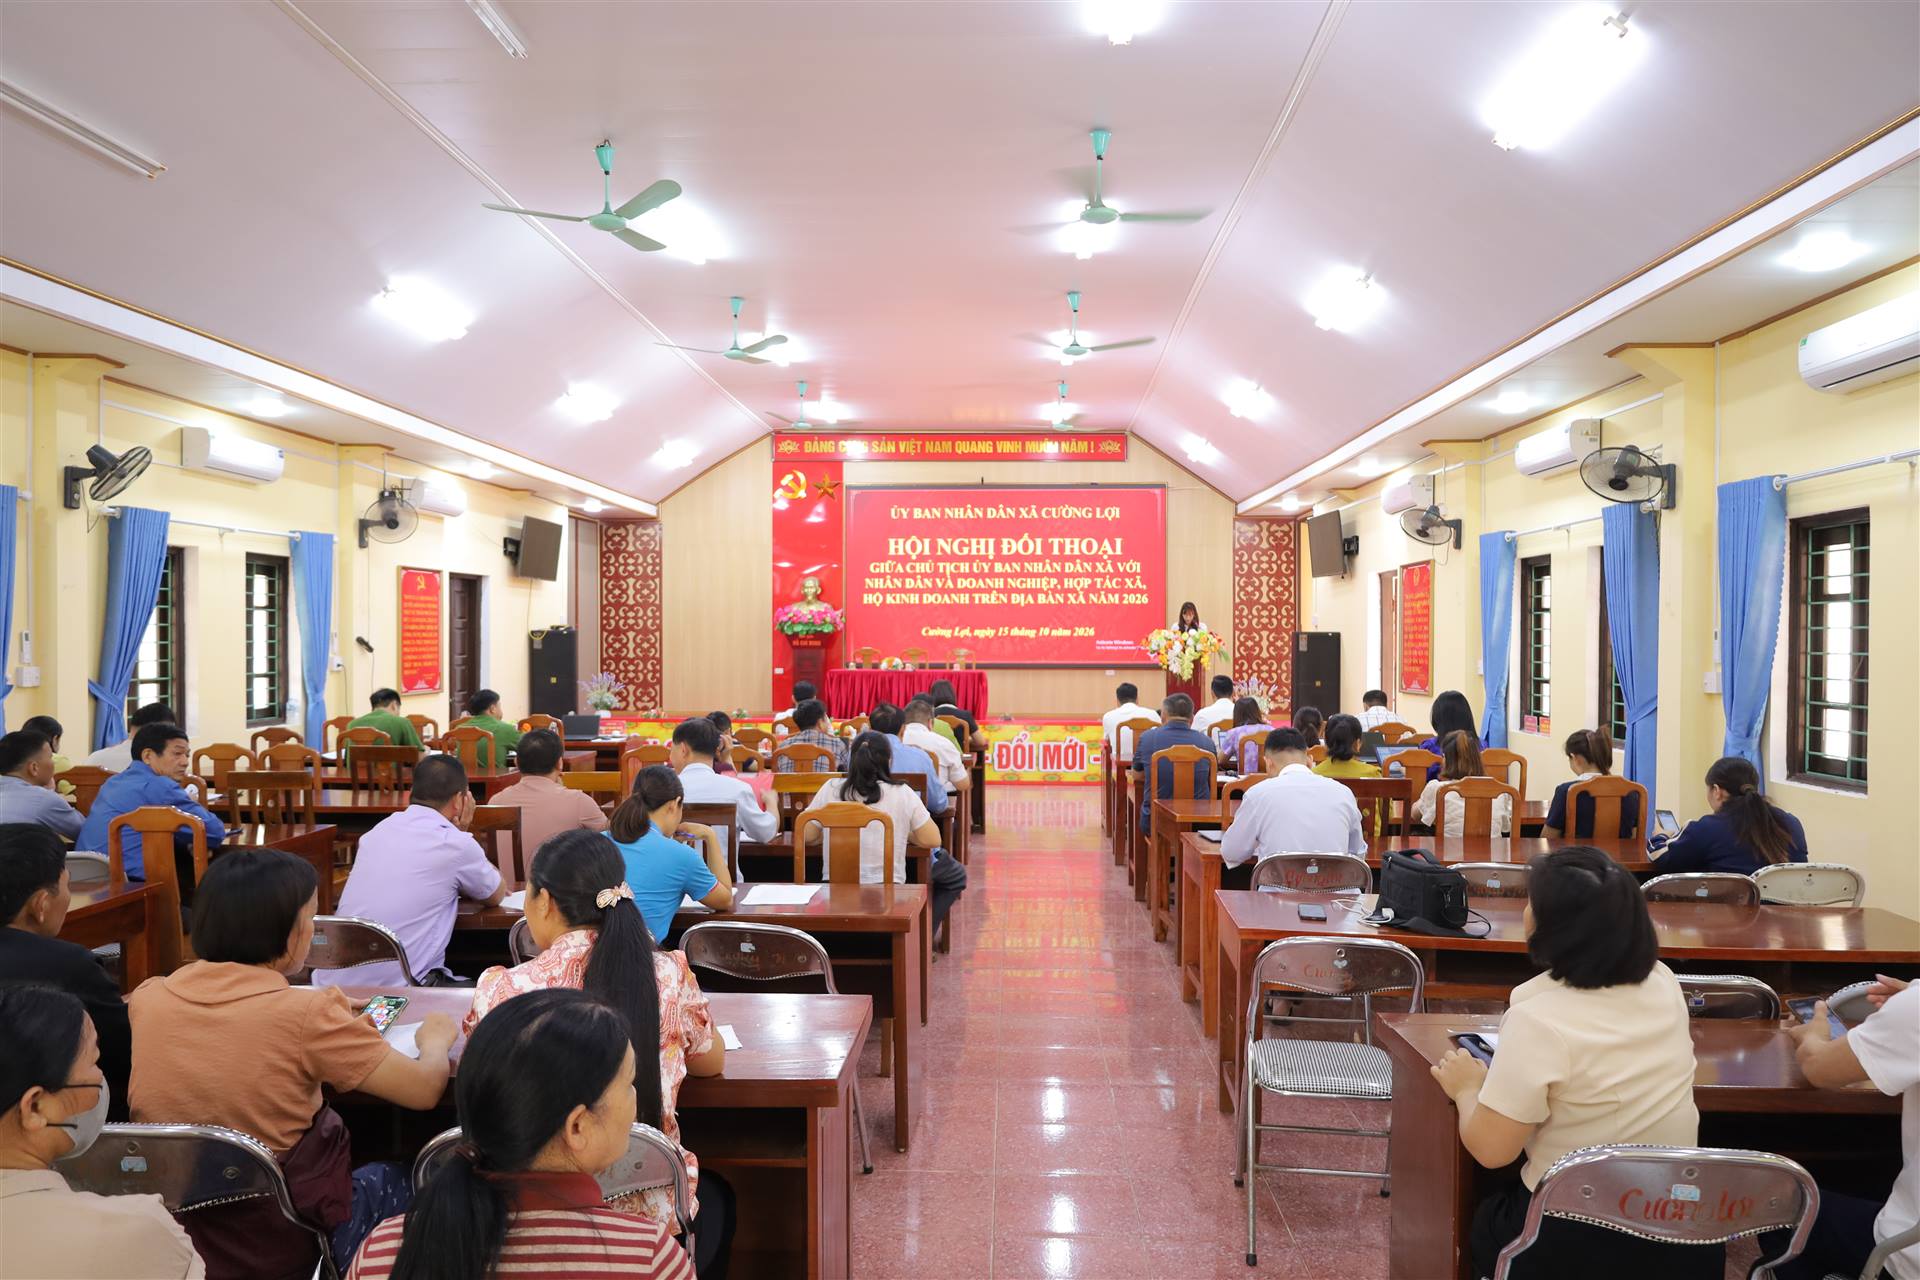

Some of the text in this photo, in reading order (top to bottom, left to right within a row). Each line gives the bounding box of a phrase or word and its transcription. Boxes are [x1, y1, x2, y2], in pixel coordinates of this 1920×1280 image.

[803, 436, 835, 453] ĐẢNG
[871, 436, 896, 453] SẢN
[898, 437, 922, 455] VIỆT
[925, 440, 952, 453] NAM
[955, 440, 993, 454] QUANG
[996, 440, 1022, 453] VINH
[1061, 437, 1088, 453] NĂM
[890, 504, 1121, 521] ỦY BAN NHÂN DÂN XÃ CƯỜNG LỢI
[888, 532, 1123, 560] HỘI NGHỊ ĐỐI THOẠI
[869, 559, 1141, 575] GIỮA CHỦ TỊCH ỦY BAN NHÂN DÂN XÃ VỚI
[865, 575, 1147, 591] NHÂN DÂN VÀ DOANH NGHIỆP, HỢP TÁC XÃ,
[863, 590, 1149, 607] HỘ KINH DOANH TRÊN ĐỊA BÀN XÃ NĂM 2026
[973, 626, 996, 639] ngày
[998, 626, 1009, 637] 15
[1010, 626, 1036, 638] tháng
[1039, 626, 1050, 637] 10
[1072, 626, 1095, 637] 2026
[995, 731, 1036, 772] ĐỔI
[1040, 736, 1087, 772] MỚI
